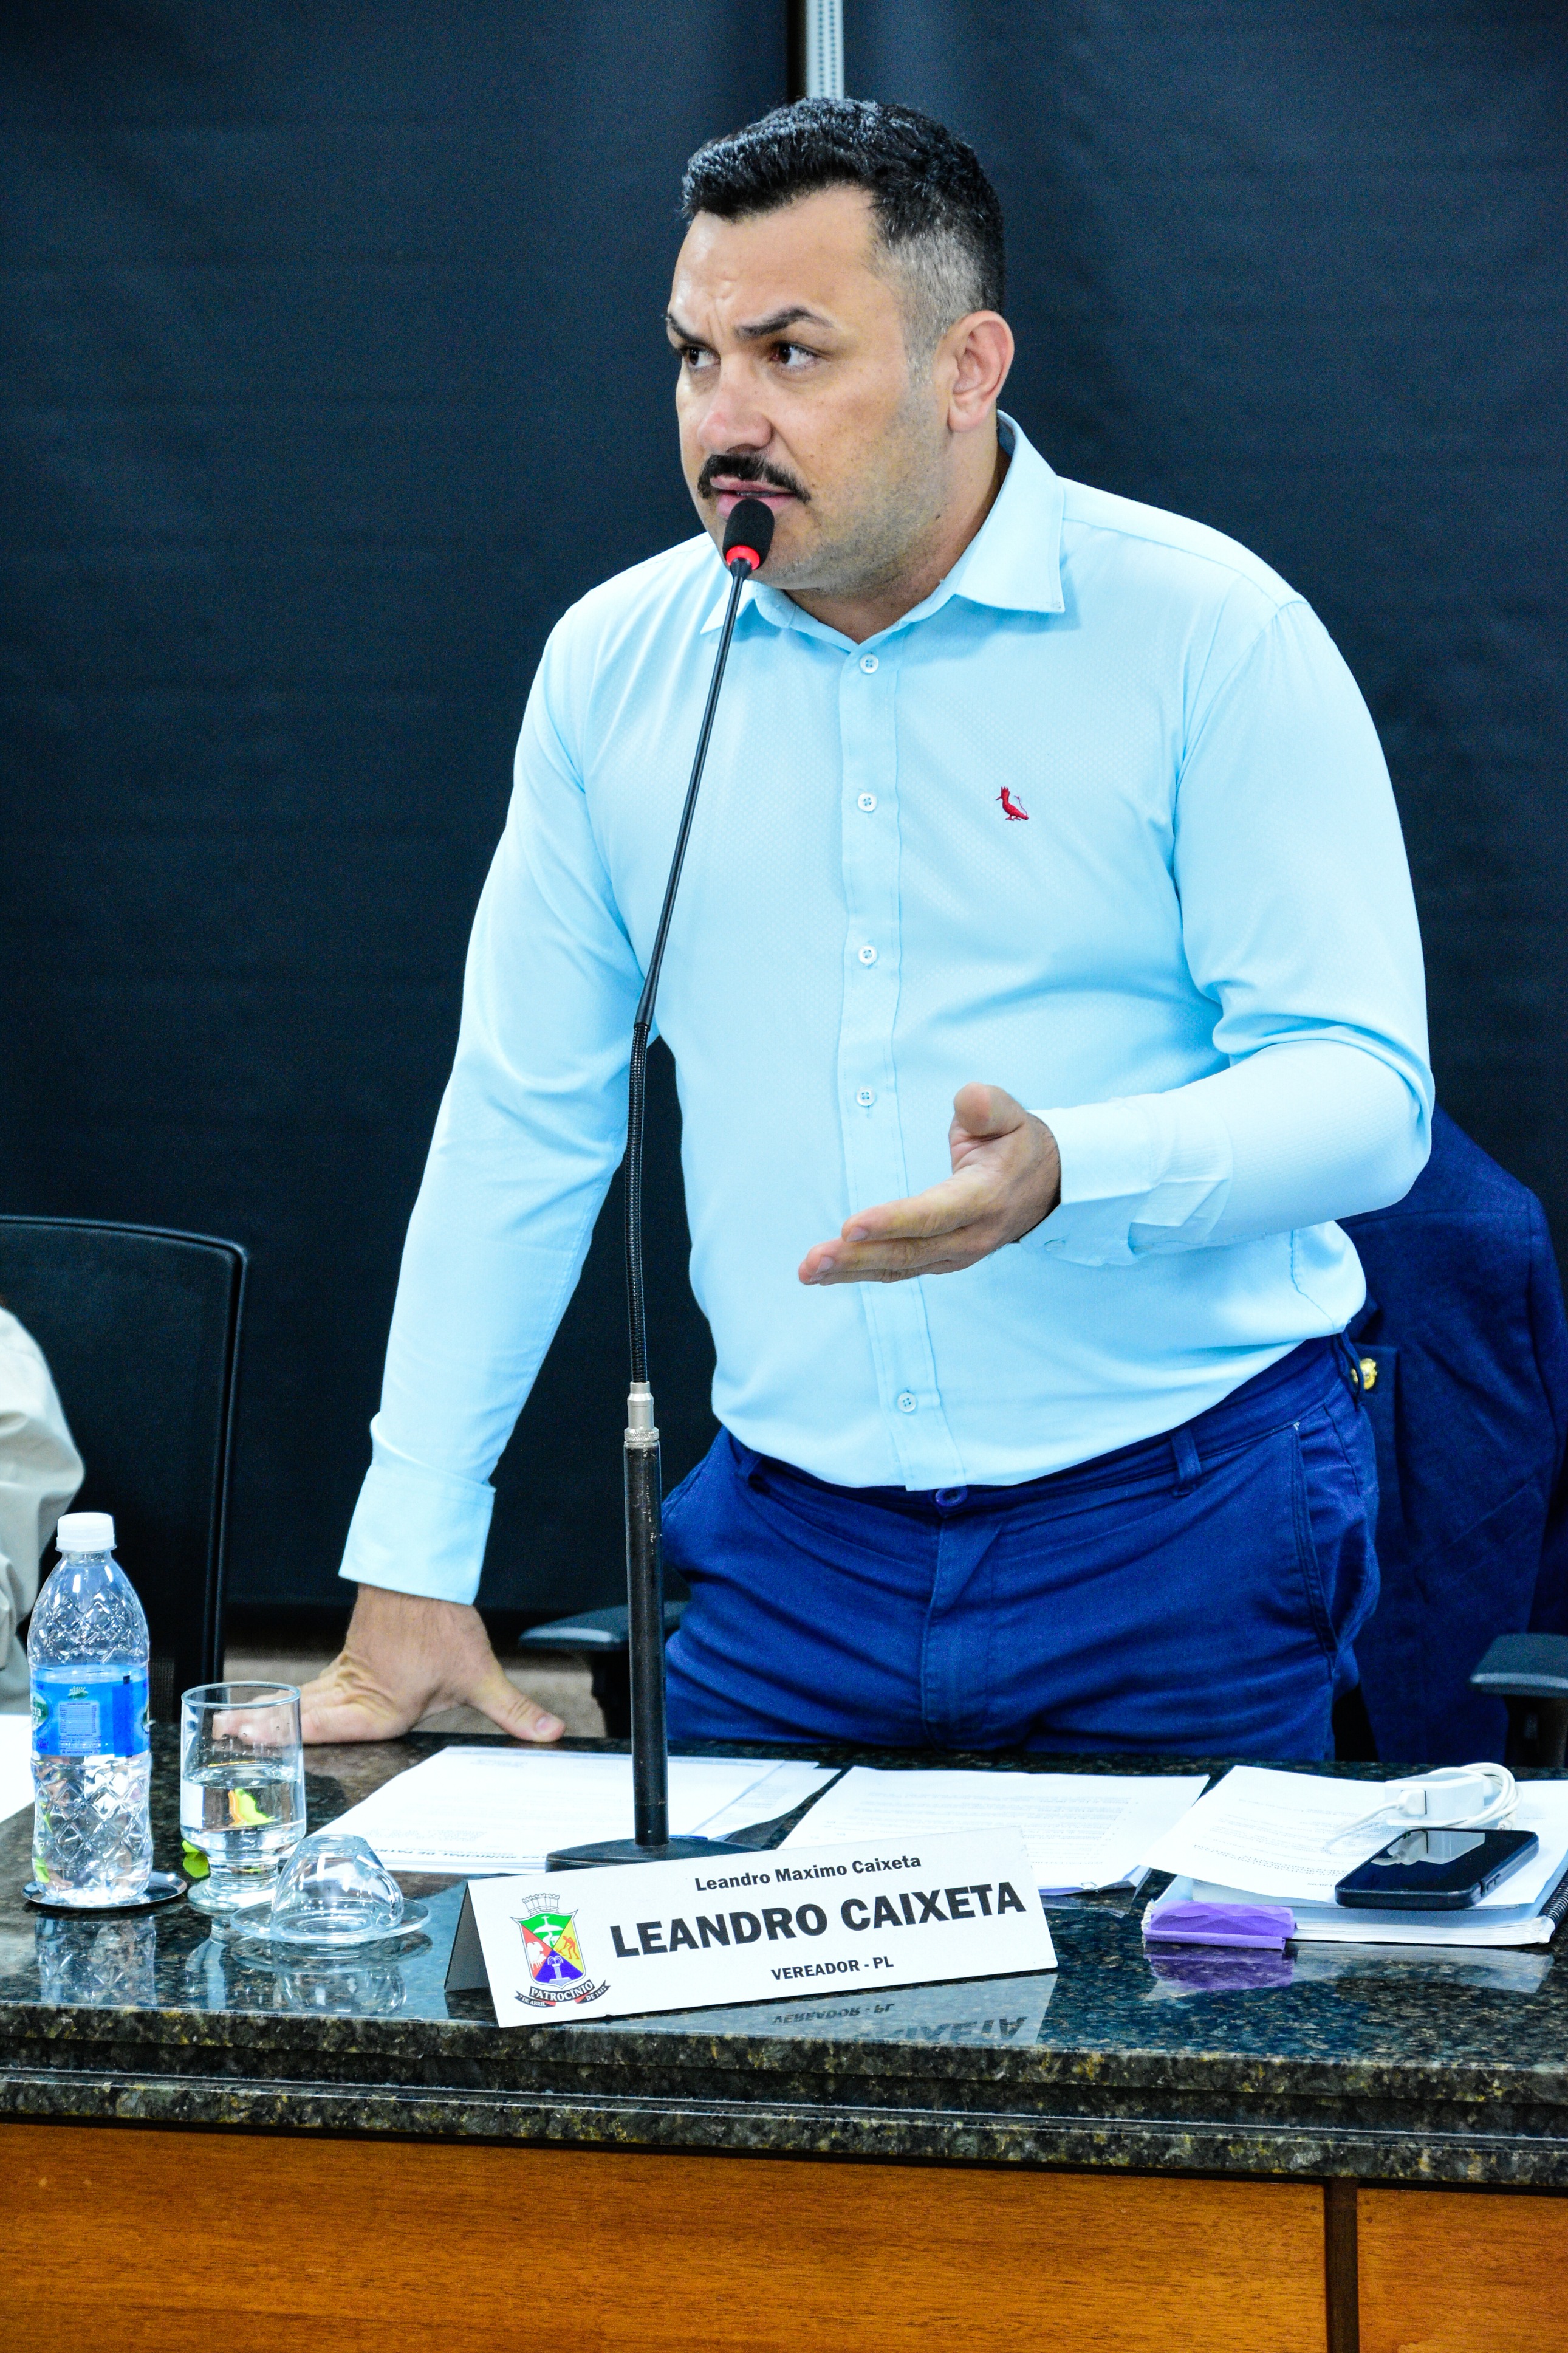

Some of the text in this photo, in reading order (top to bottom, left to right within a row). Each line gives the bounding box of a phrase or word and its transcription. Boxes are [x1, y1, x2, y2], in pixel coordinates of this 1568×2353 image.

[695, 1855, 922, 1891] Leandro Maximo Caixeta
[610, 1881, 1027, 1958] LEANDRO CAIXETA
[771, 1960, 860, 1980] VEREADOR
[872, 1956, 894, 1969] PL
[530, 1982, 593, 2001] PATROCÍNIO
